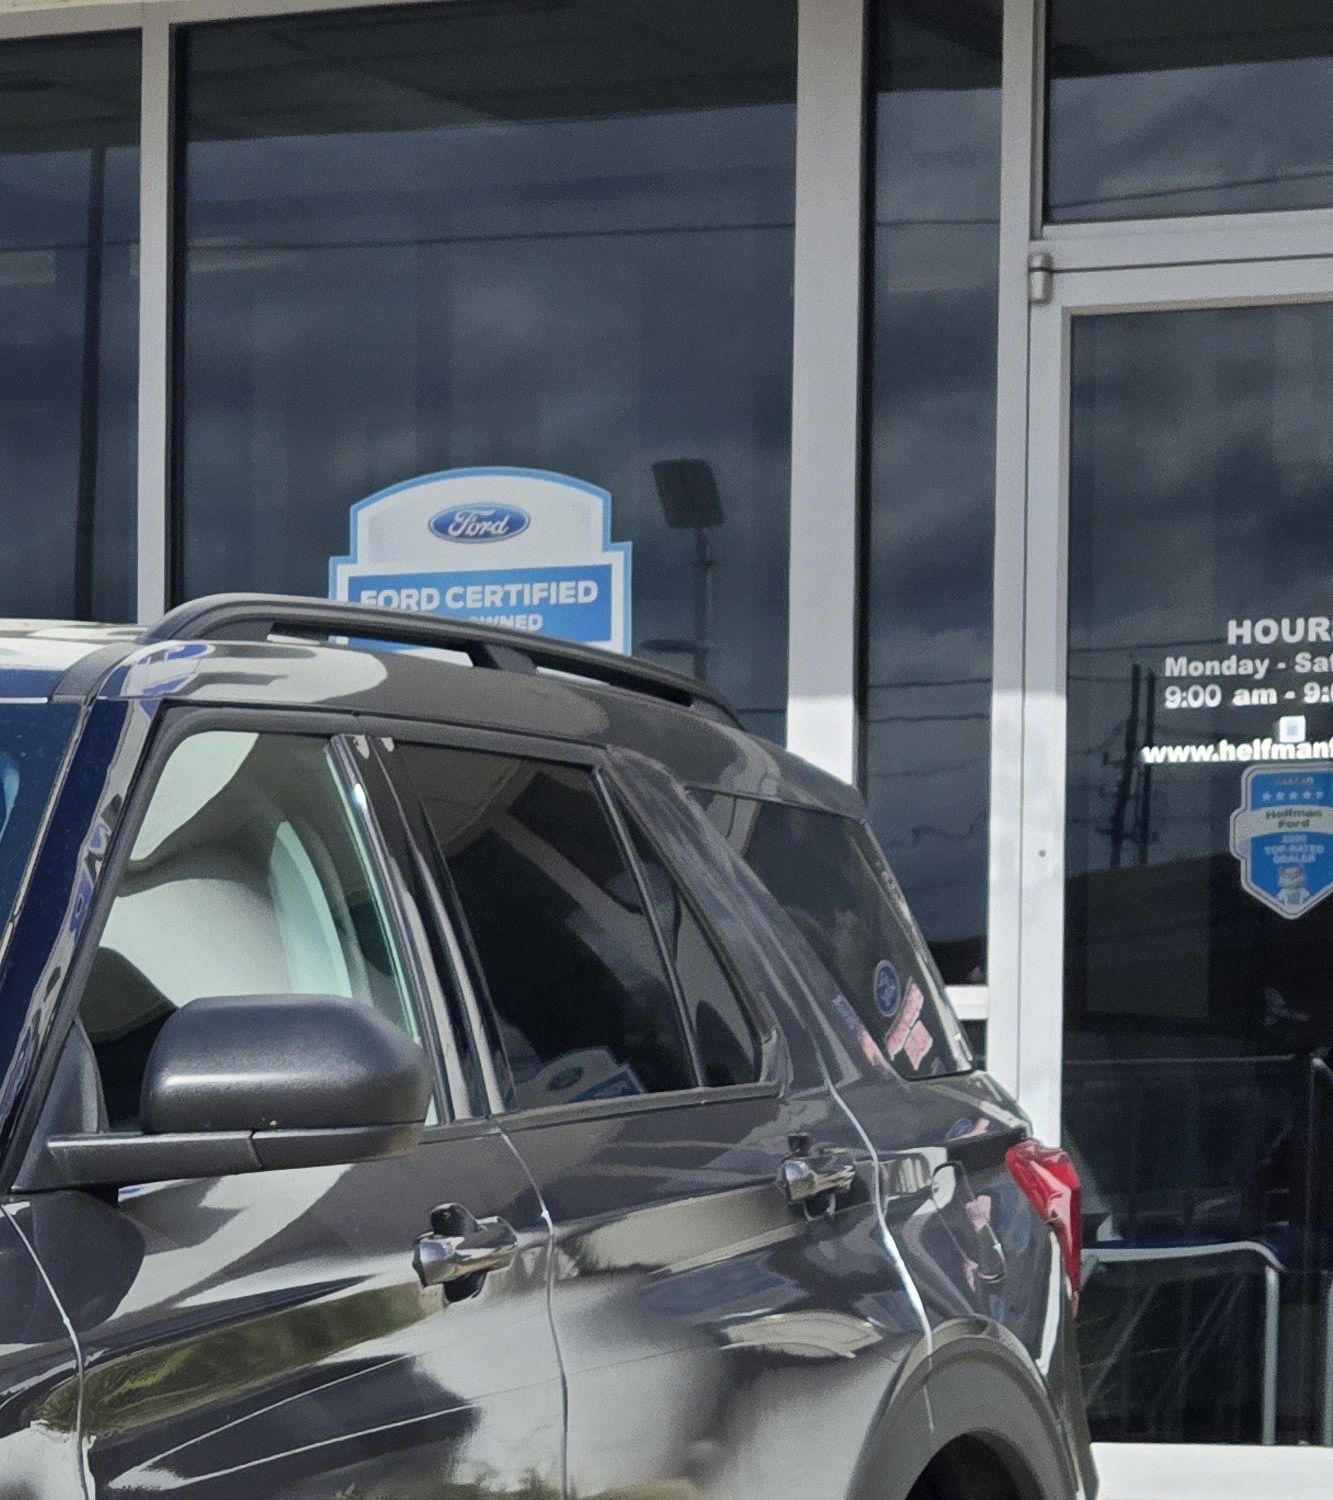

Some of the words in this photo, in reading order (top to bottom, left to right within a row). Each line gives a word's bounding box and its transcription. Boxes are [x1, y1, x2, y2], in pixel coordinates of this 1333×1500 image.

[447, 507, 511, 537] Ford
[360, 587, 441, 612] FORD
[445, 580, 599, 609] CERTIFIED
[1227, 616, 1333, 646] HOUR
[1164, 654, 1270, 680] Monday
[1164, 684, 1222, 709] 9:00
[1231, 687, 1278, 707] am
[1303, 681, 1333, 705] 9:
